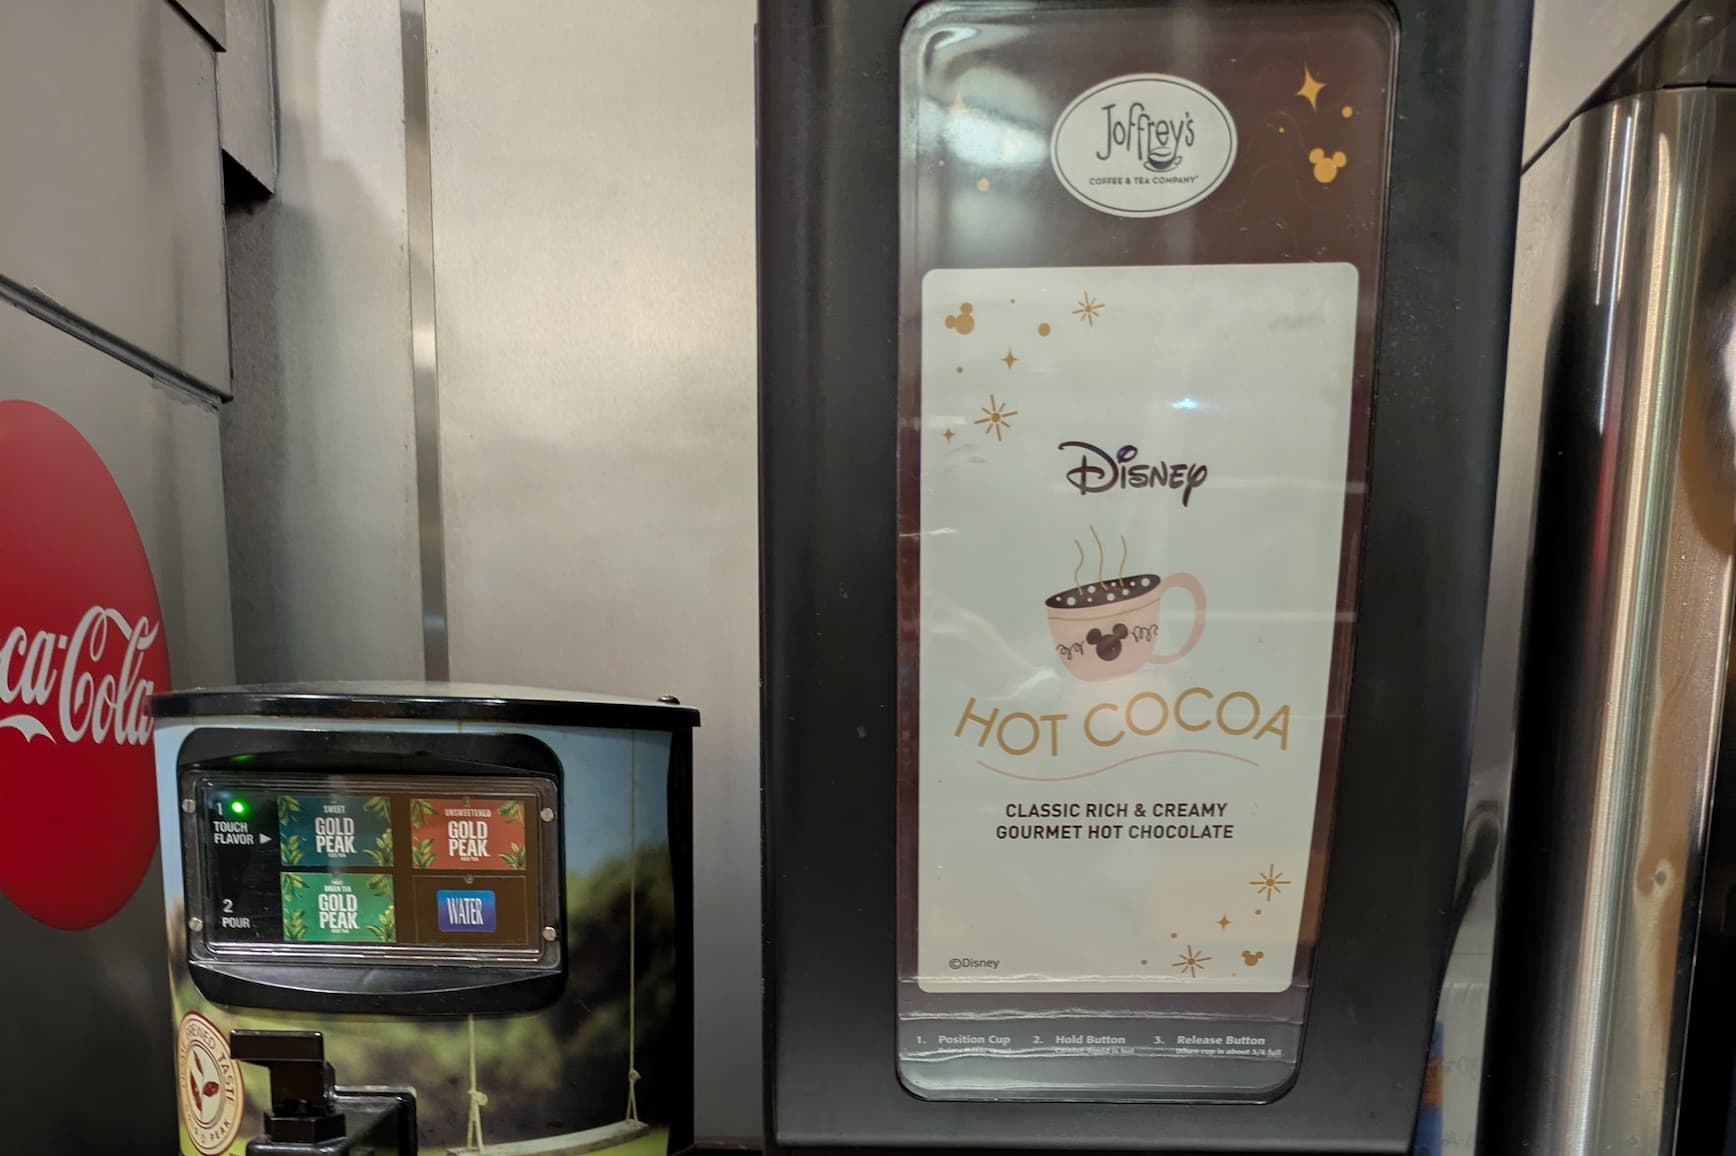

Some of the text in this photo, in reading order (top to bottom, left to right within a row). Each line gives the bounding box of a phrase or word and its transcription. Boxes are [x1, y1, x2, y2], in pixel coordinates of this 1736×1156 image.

[1096, 102, 1195, 164] Joffrey's
[1089, 178, 1122, 186] COFFEE
[1134, 177, 1151, 185] TEA
[954, 687, 1291, 757] HOT COCOA
[217, 802, 223, 816] 1
[323, 805, 346, 814] SWEET
[1005, 803, 1228, 818] CLASSIC RICH & CREAMY
[213, 821, 248, 833] TOUCH
[315, 817, 355, 836] GOLD
[447, 820, 488, 840] GOLD
[996, 825, 1234, 840] GOURMET HOT CHOCOLATE
[213, 833, 254, 845] FLAVOR
[316, 835, 357, 854] PEAK
[448, 839, 491, 857] PEAK
[223, 899, 233, 913] 2
[318, 894, 358, 912] GOLD
[447, 897, 484, 925] WATER
[222, 917, 251, 928] POUR
[319, 911, 360, 929] PEAK
[916, 1035, 1011, 1046] 1. Position Cup
[1032, 1035, 1126, 1045] 2. Hold Button
[1153, 1035, 1265, 1045] 3. Release Button
